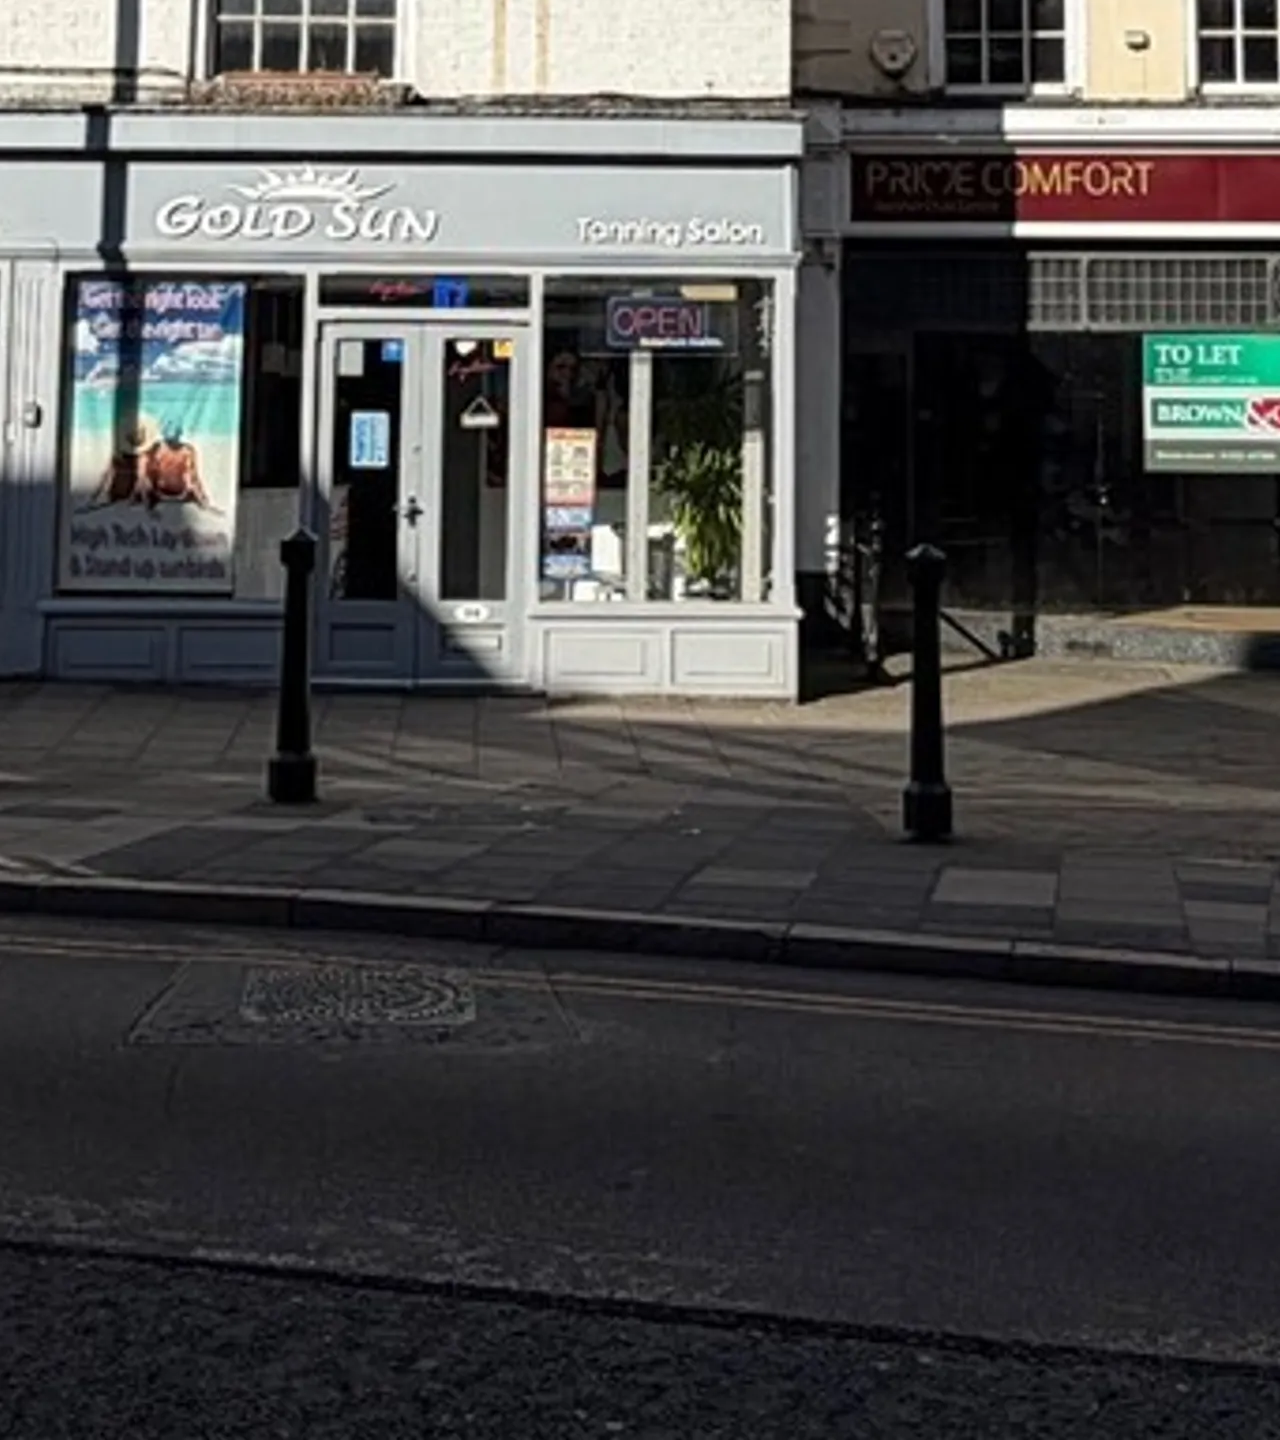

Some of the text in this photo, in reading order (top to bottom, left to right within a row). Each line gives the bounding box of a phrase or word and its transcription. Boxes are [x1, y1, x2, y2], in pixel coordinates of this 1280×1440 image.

[866, 161, 1155, 197] PRIME COMFORT
[156, 195, 439, 242] GOLD SUN
[577, 216, 765, 247] Tanning Salon
[613, 305, 703, 337] OPEN
[1154, 343, 1243, 366] TO LET
